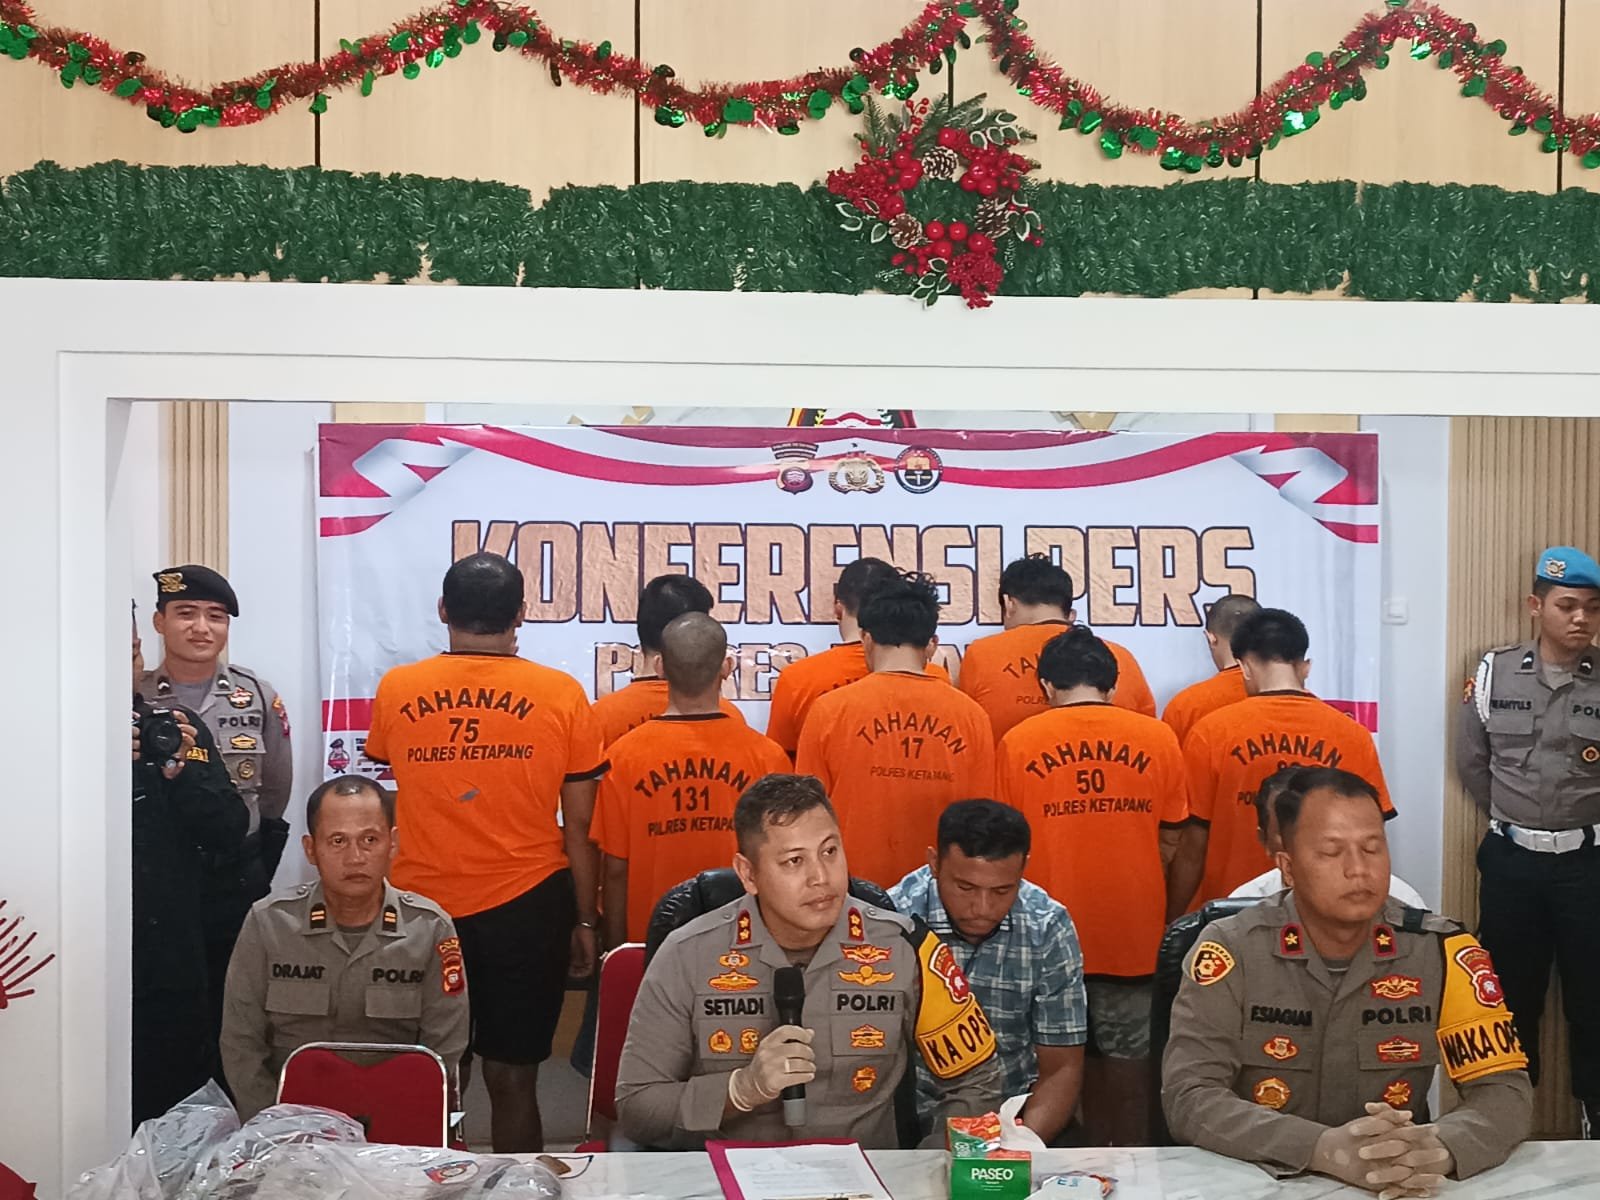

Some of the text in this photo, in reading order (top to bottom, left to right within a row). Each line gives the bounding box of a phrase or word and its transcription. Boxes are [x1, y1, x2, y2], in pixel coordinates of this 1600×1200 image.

[1024, 525, 1256, 627] PERS
[400, 688, 534, 723] TAHANAN
[1016, 696, 1051, 706] POLR
[1573, 704, 1600, 718] POL
[449, 717, 479, 743] 75
[857, 711, 967, 755] TAHANAN
[408, 744, 533, 762] POLRES KETAPANG
[902, 736, 923, 759] 17
[1025, 740, 1152, 779] TAHANAN
[1231, 733, 1342, 768] TAHANAN
[634, 757, 751, 798] TAHANAN
[1076, 769, 1105, 794] 50
[672, 785, 710, 812] 131
[1043, 798, 1152, 817] POLRES KETAPANG
[648, 817, 736, 836] POLRES KETAPA
[272, 963, 326, 979] DRAJAT
[704, 998, 764, 1016] SETIADI
[836, 994, 896, 1012] POLRI
[1362, 1005, 1432, 1026] POLRI
[926, 1034, 963, 1069] KA
[1441, 1025, 1498, 1070] WAKA
[971, 1167, 1013, 1181] PASEO
